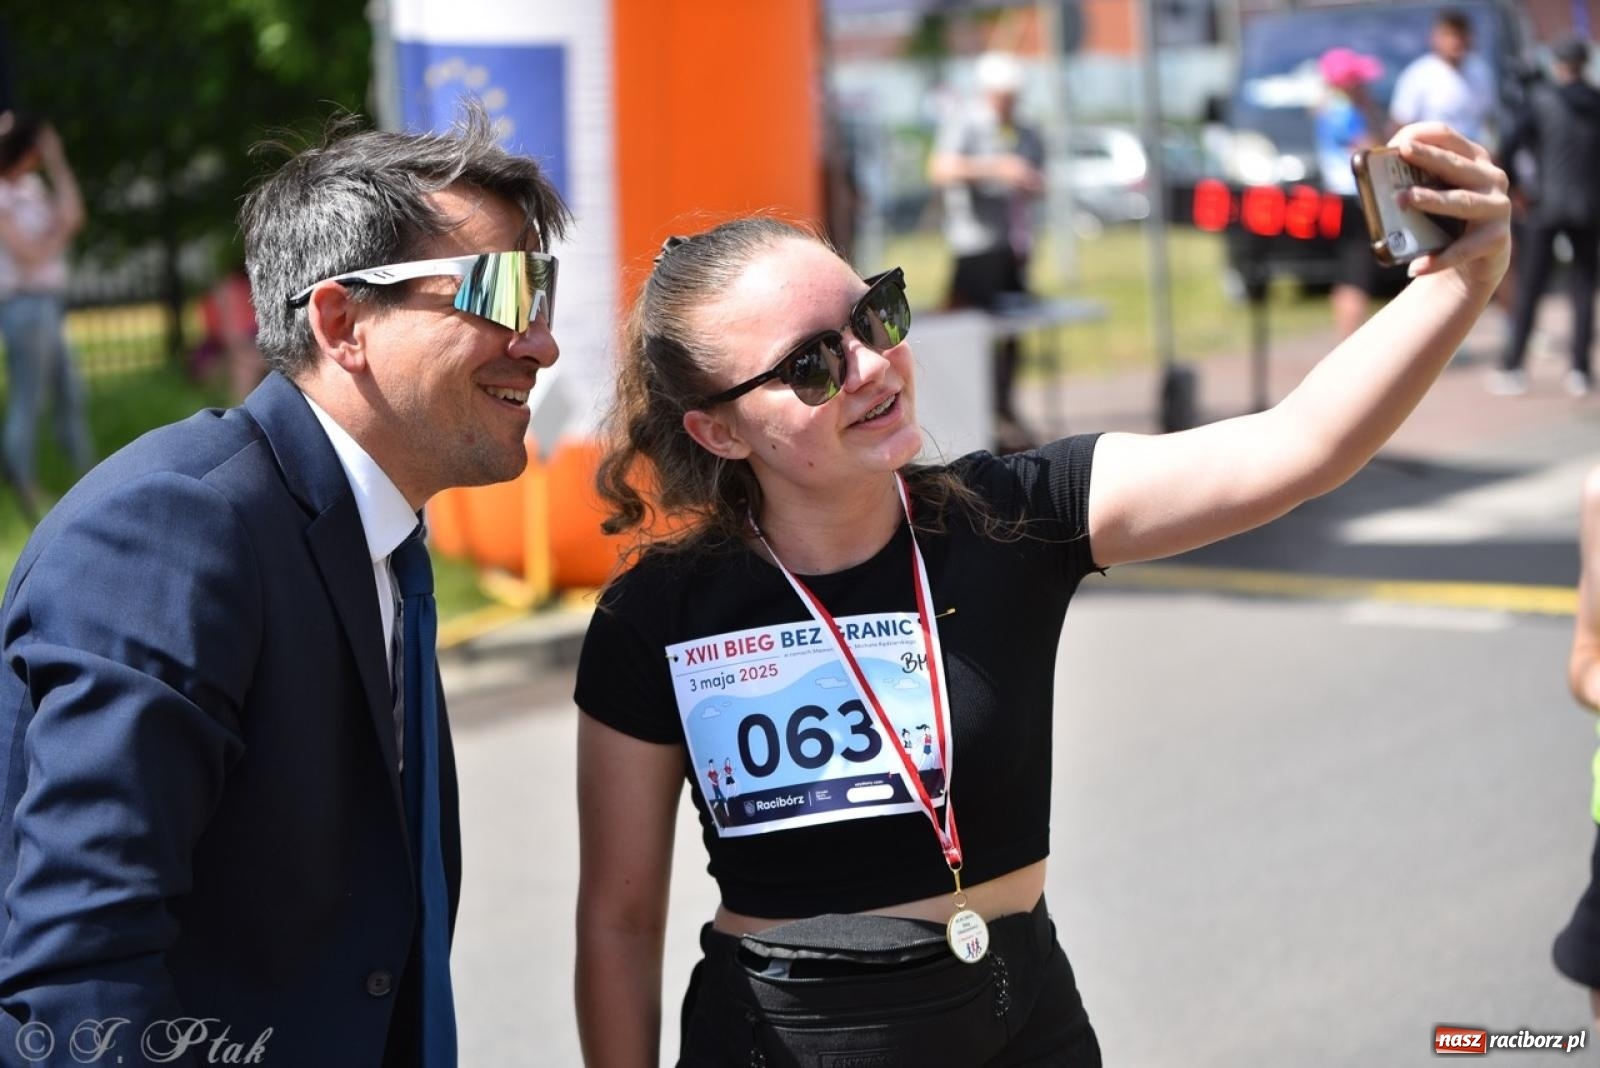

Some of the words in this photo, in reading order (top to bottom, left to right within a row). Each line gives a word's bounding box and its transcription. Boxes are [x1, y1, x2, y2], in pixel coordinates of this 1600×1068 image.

[685, 643, 719, 666] XVII
[724, 633, 775, 658] BIEG
[780, 627, 823, 649] BEZ
[690, 678, 697, 692] 3
[700, 672, 735, 690] maja
[740, 663, 778, 682] 2025
[737, 699, 882, 778] 063
[756, 794, 805, 812] Racibórz
